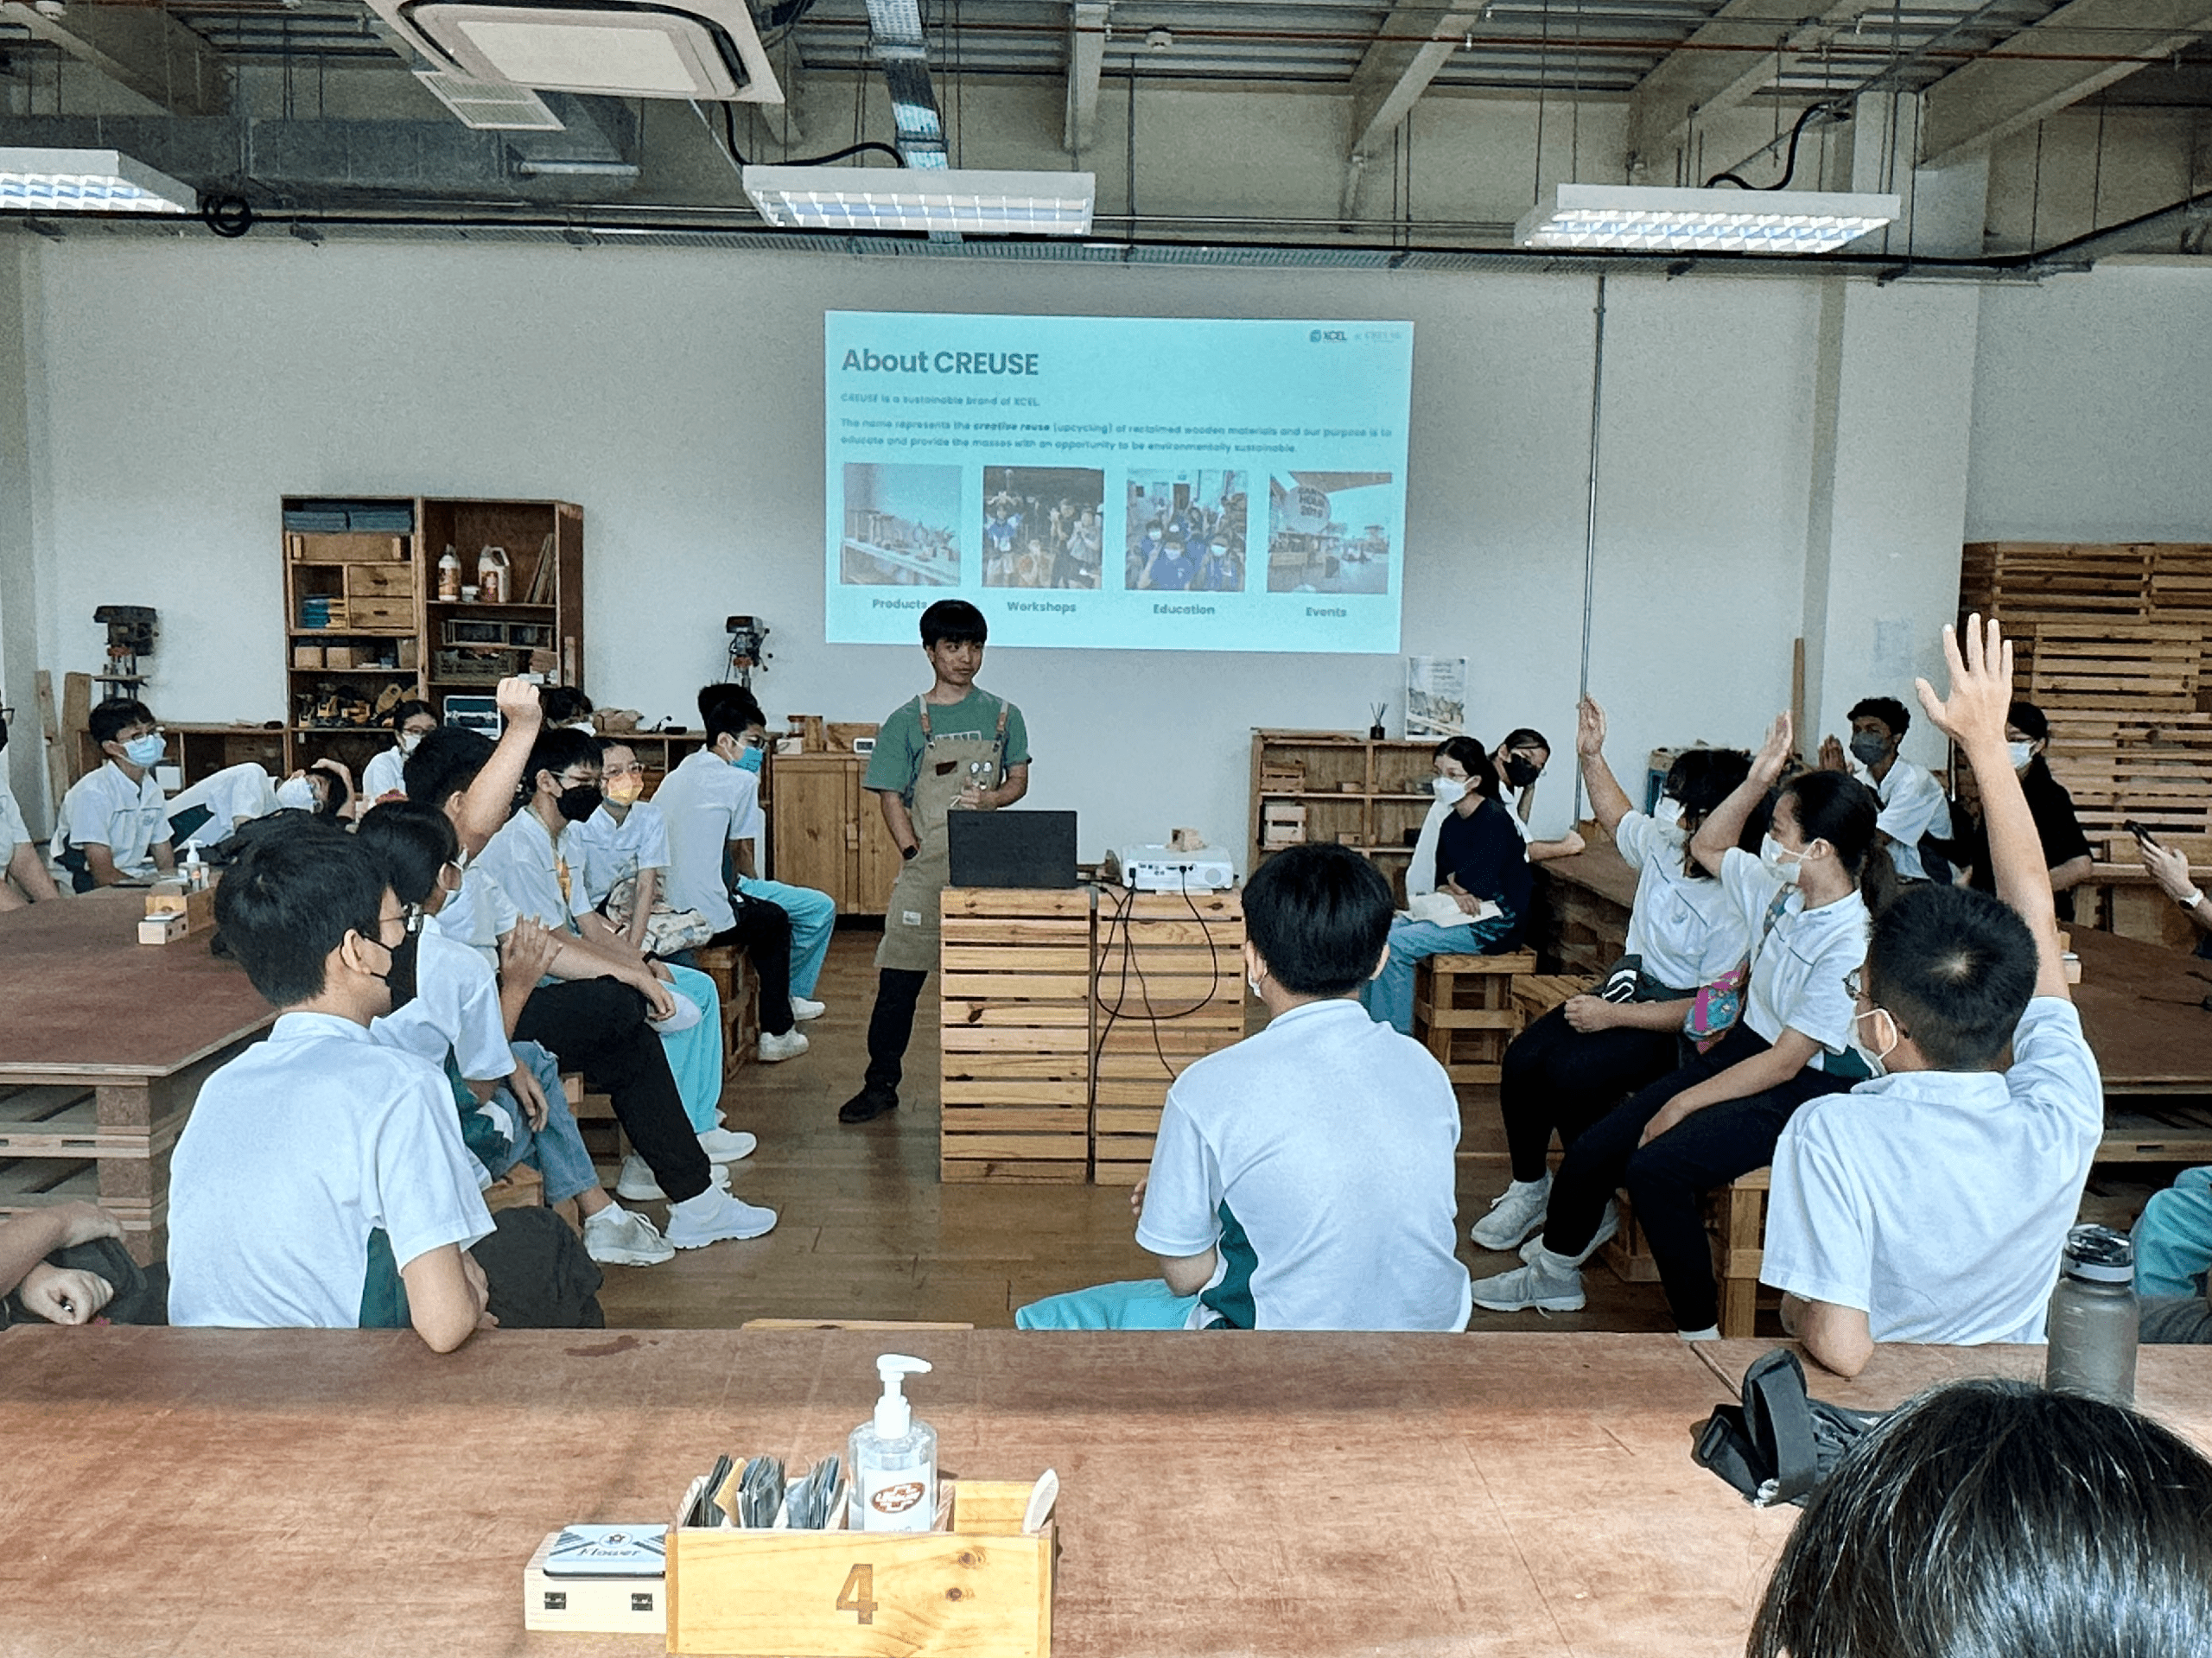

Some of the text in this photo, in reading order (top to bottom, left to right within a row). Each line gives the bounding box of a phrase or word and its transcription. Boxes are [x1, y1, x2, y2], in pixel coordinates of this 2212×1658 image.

[842, 348, 1039, 376] About CREUSE
[880, 394, 891, 403] is
[893, 396, 899, 404] a
[903, 395, 963, 405] sustainable
[966, 396, 997, 406] brand
[1000, 397, 1011, 407] of
[840, 418, 860, 428] The
[861, 420, 893, 429] name
[895, 420, 950, 431] represents
[953, 421, 970, 430] the
[973, 422, 1018, 431] creative
[1116, 424, 1127, 433] of
[1128, 425, 1182, 434] reclaimed
[1184, 426, 1225, 435] wooden
[1227, 427, 1278, 435] materials
[1280, 428, 1301, 436] and
[1323, 429, 1367, 438] purpose
[840, 435, 885, 445] educate
[887, 436, 908, 446] and
[910, 436, 950, 448] provide
[952, 437, 969, 447] the
[972, 439, 1013, 448] masses
[1014, 438, 1036, 448] with
[1039, 440, 1053, 448] an
[1054, 441, 1116, 451] opportunity
[1118, 441, 1129, 450] to
[1131, 441, 1145, 450] be
[1147, 441, 1231, 454] environmentally
[872, 598, 928, 610] Products
[1007, 600, 1077, 614] Workshops
[1153, 603, 1216, 615] Education
[1305, 607, 1347, 618] Events
[836, 1563, 879, 1625] 4
